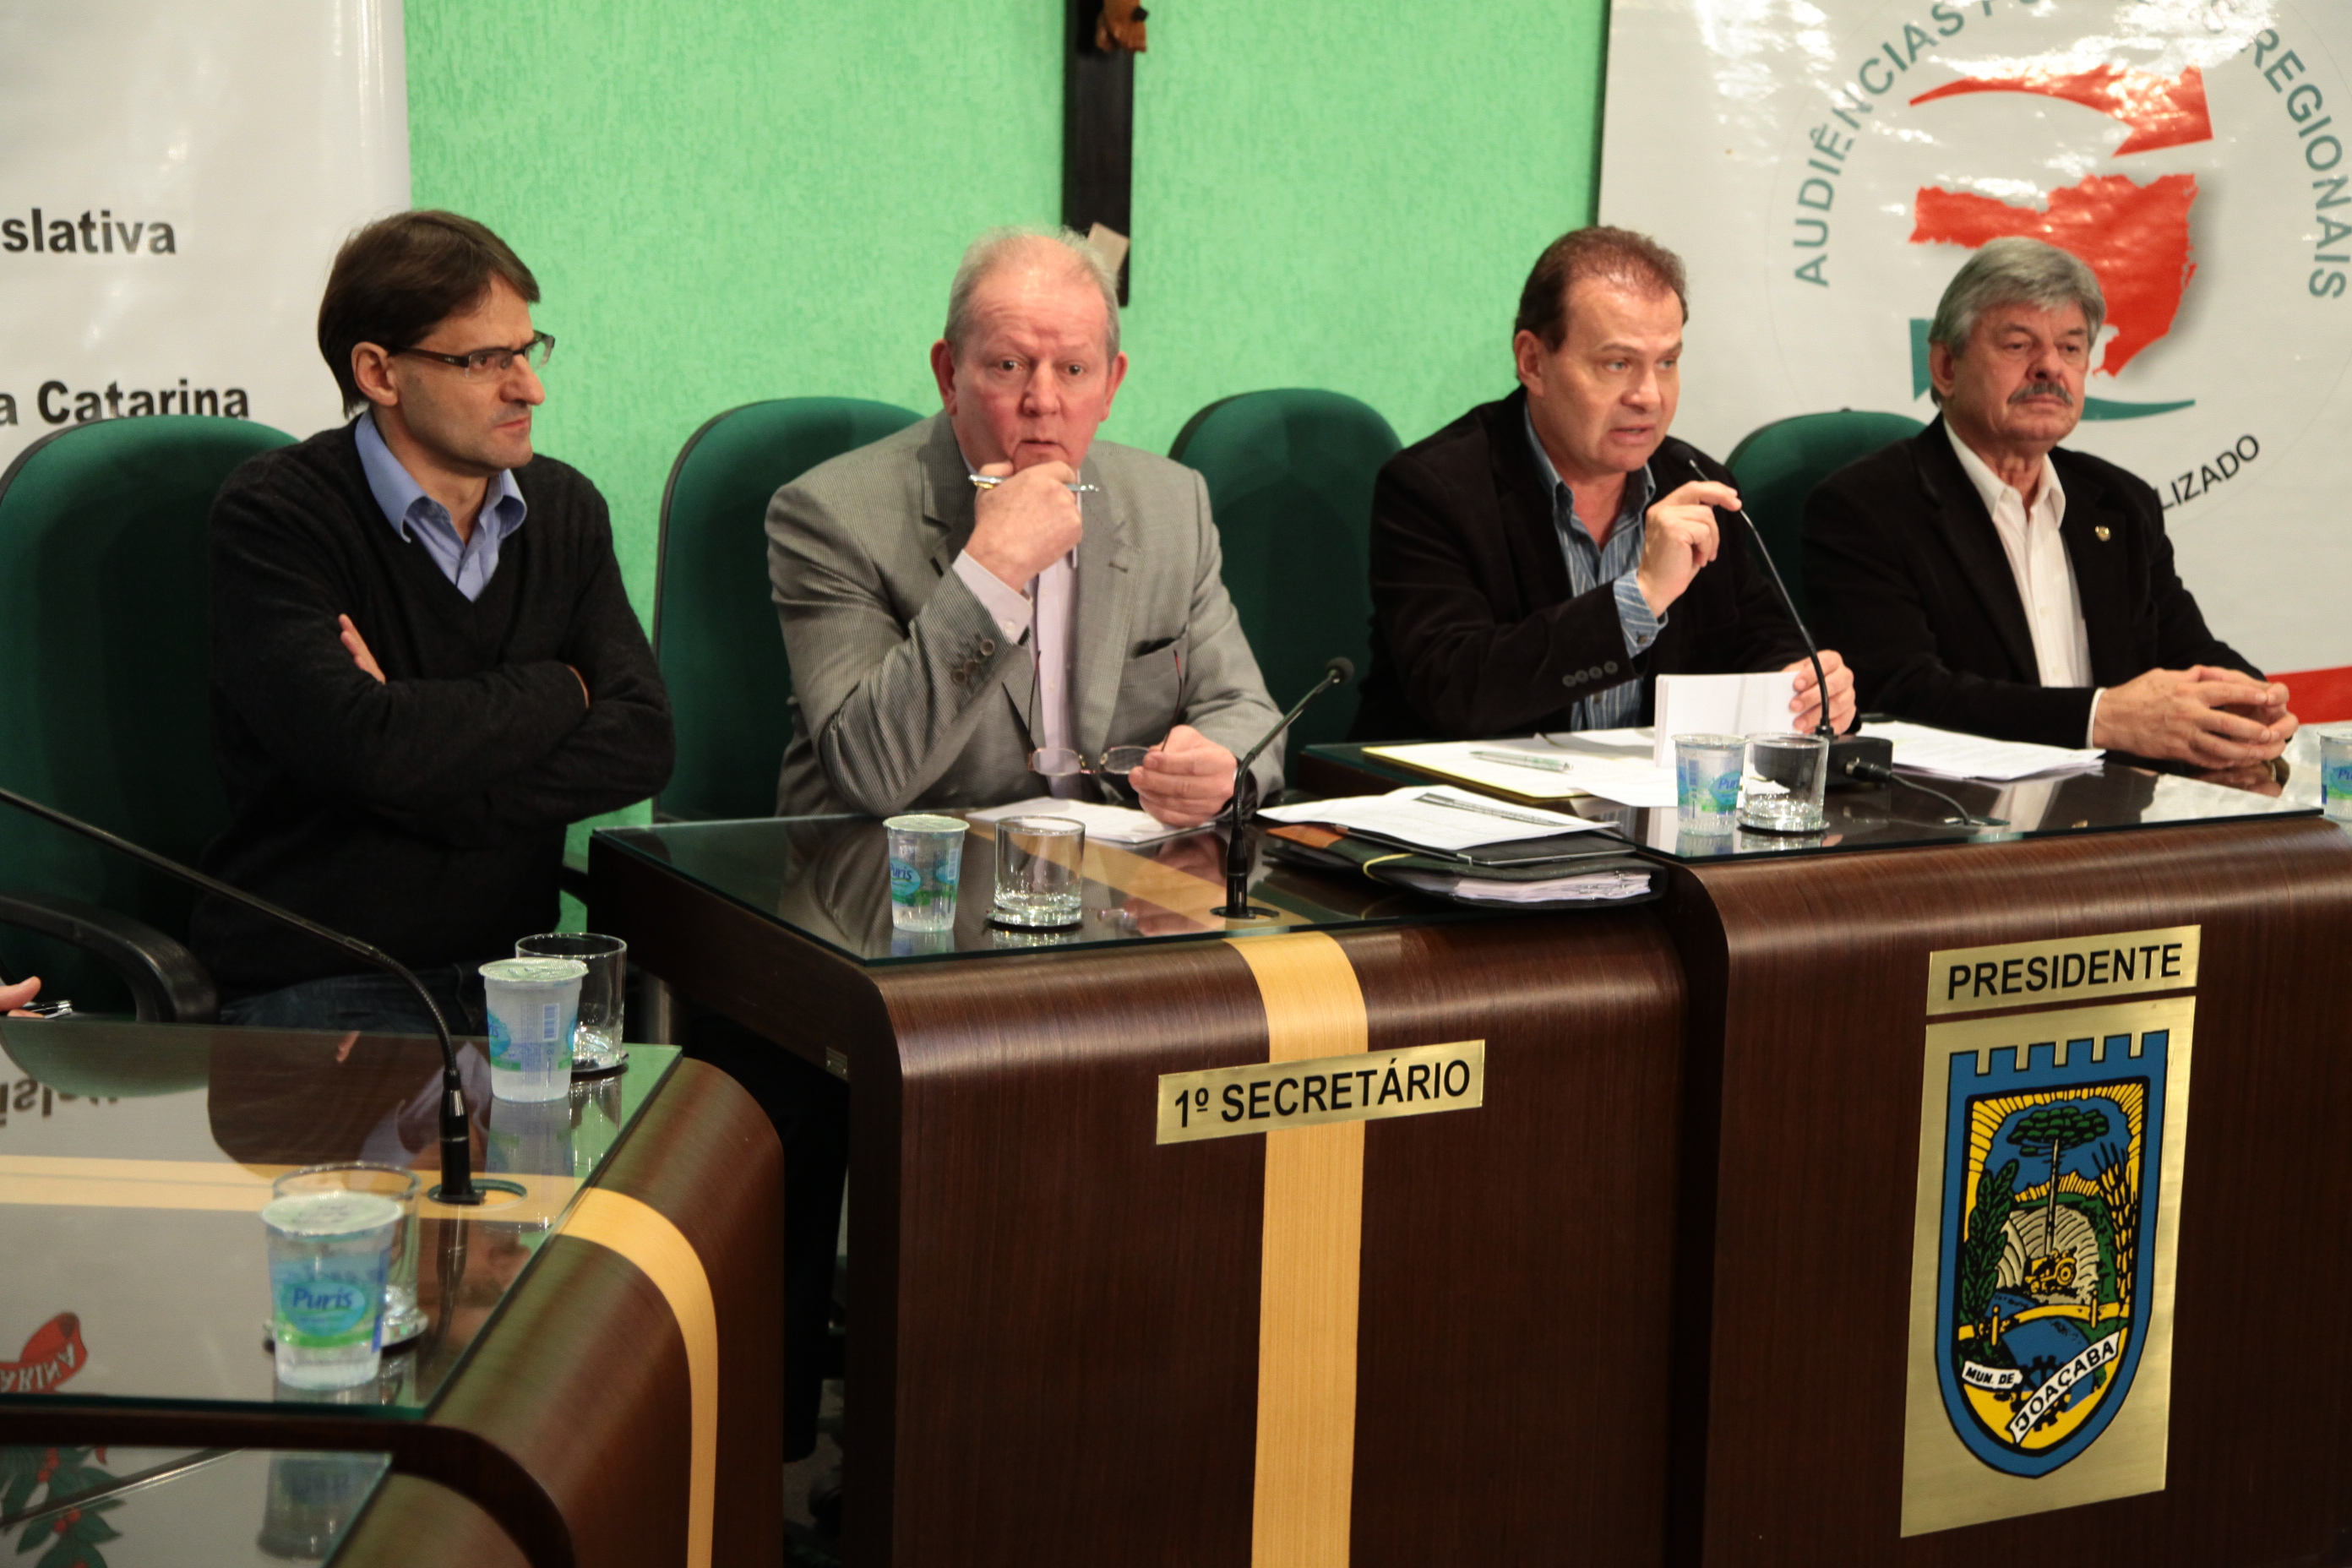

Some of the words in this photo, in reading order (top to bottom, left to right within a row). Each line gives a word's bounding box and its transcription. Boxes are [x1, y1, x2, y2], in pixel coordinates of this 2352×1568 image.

[2240, 28, 2352, 300] REGIONAIS
[1, 208, 177, 254] slativa
[37, 378, 249, 424] Catarina
[1947, 943, 2183, 1000] PRESIDENTE
[1222, 1058, 1471, 1123] SECRETÁRIO
[292, 1285, 354, 1310] Puris
[1998, 1372, 2015, 1385] DE
[2015, 1340, 2115, 1431] JOAÇABA
